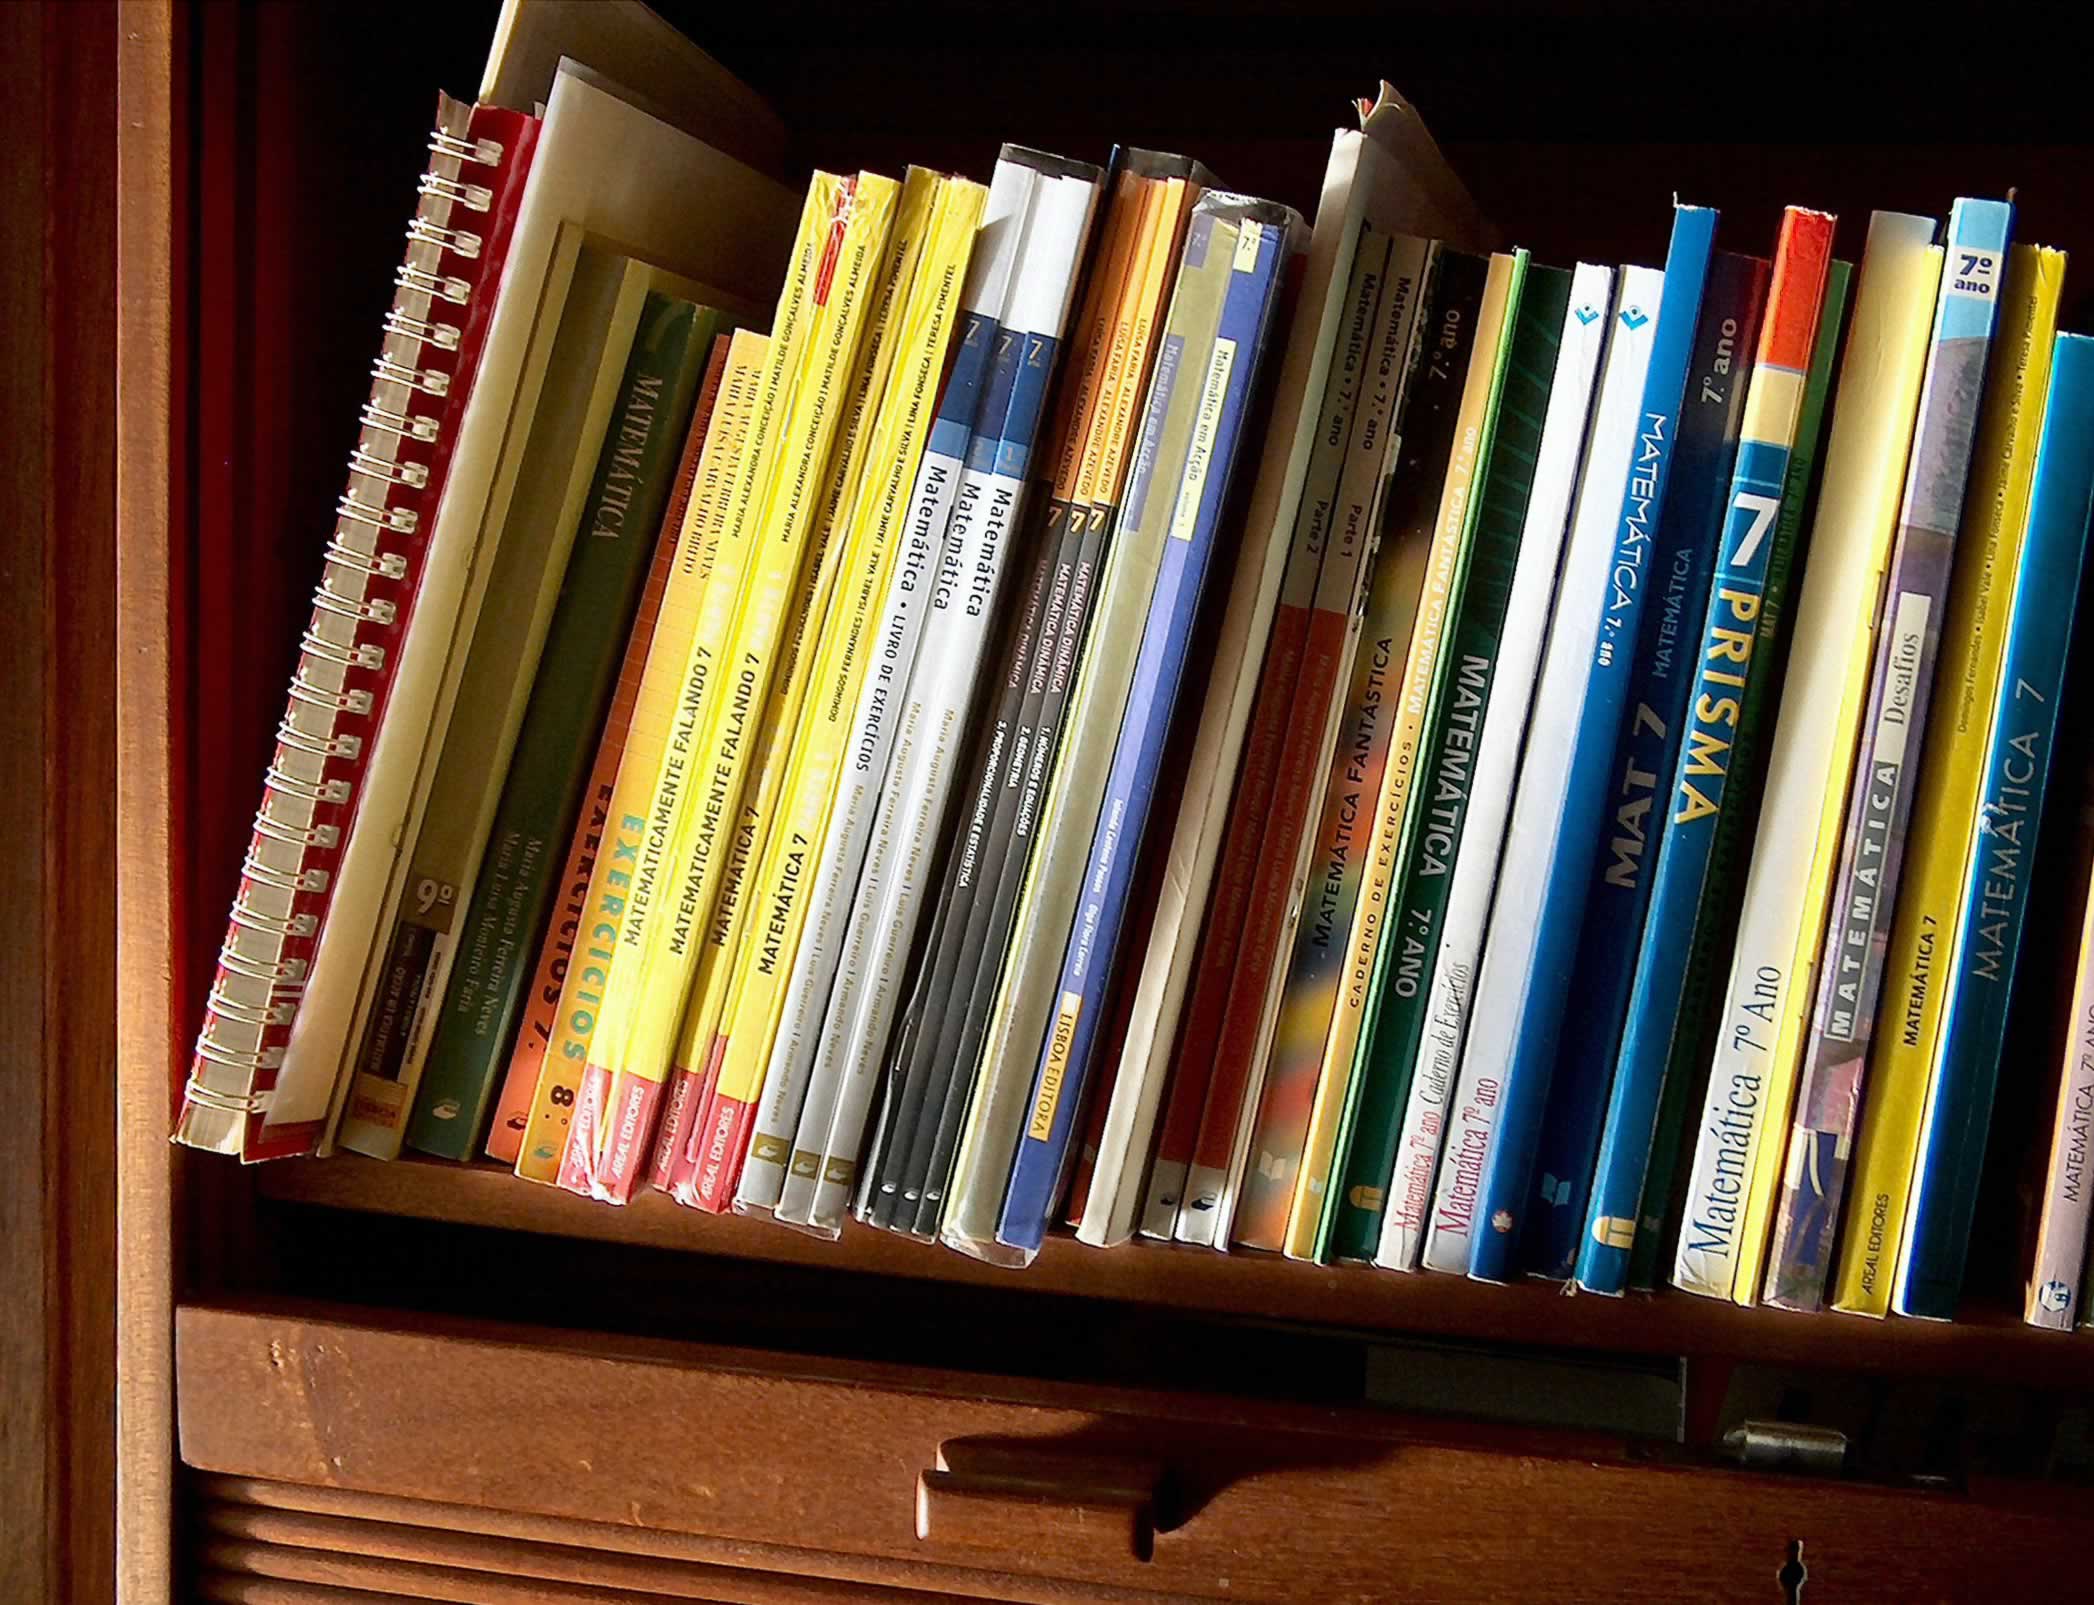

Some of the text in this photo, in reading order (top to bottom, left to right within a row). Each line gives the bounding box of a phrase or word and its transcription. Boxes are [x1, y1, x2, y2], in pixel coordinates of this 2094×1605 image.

[1954, 279, 1990, 294] ano
[1960, 254, 1992, 276] 7º
[1030, 340, 1042, 360] 7
[1329, 273, 1376, 448] Matemática ano
[1363, 277, 1410, 451] Matemática ano
[1436, 306, 1462, 350] ano
[1707, 315, 1739, 376] ano
[731, 285, 804, 538] MARIA ALEXANDRA CONCEIÇÃO MATILDE GONÇALVES
[742, 367, 762, 410] MARIA
[779, 243, 866, 543] MARIA ALEXANDRA CONCEIÇÃO MATILDE GONÇALVES ALMEIDA
[1056, 384, 1088, 491] ALEXANDRE AZEVEDO
[1078, 351, 1121, 496] FARIA ALEXANDRE AZEVEDO
[1098, 348, 1140, 494] FARIA ALEXANDRE AZEVEDO
[1145, 416, 1162, 438] em
[1187, 348, 1229, 482] Matemática em Acção
[591, 371, 663, 543] MATEMÁTICA
[680, 362, 747, 575] MARIA CARVALHO BRITO
[726, 413, 751, 471] AUGUSTA
[710, 471, 736, 536] FERREIRA
[827, 263, 956, 722] DOMINGOS FERNANDES ISABEL VALE JAIME CARVALHO SILVA LINA FONSECA TERESA PIMENTEL
[1048, 507, 1062, 528] 7
[1070, 510, 1086, 532] 7
[1090, 509, 1104, 531] 7
[1306, 499, 1328, 554] Parte 2
[1594, 412, 1667, 668] MATEMÁTICA ano
[1732, 492, 1779, 566] 7
[698, 537, 719, 581] NEVES
[932, 482, 981, 612] Matemática
[965, 487, 1013, 618] Matemática
[854, 464, 948, 773] Matemática LIVRO DE EXERCÍCIOS
[1028, 562, 1071, 696] MATEMÁTICA DINÂMICA
[1049, 560, 1091, 695] MATEMÁTICA DINÂMICA
[1650, 545, 1693, 679] MATEMÁTICA
[1673, 587, 1760, 830] PRISMA
[1883, 631, 1919, 725] Desafios
[2015, 677, 2047, 705] 7
[624, 645, 712, 946] MATEMATICAMENTE FALANDO 7
[668, 651, 761, 955] MATEMATICAMENTE FALANDO 7
[1006, 724, 1030, 790] 2. GEOMETRIA
[1014, 724, 1051, 838] 1. NÚMEROS E EQUAÇÕES
[1602, 701, 1670, 889] MAT 7
[496, 829, 521, 872] Maria
[518, 835, 544, 879] Maria
[744, 805, 760, 820] 7
[878, 789, 901, 838] Ferreira
[911, 796, 933, 845] Ferreira
[957, 729, 1003, 889] PROPORCIONALIDADE ESTATÍSTICA
[1391, 653, 1490, 1000] MATEMÁTICA 7.º ANO
[757, 832, 808, 975] MATEMÁTICA 7
[1349, 912, 1377, 1008] CADERNO
[1371, 878, 1384, 902] DE
[1378, 740, 1412, 866] EXERCÍCIOS
[1830, 762, 1895, 1037] MATEMÁTICA
[472, 993, 498, 1037] Neves
[830, 976, 855, 1033] Armando
[863, 984, 887, 1040] Armando
[1903, 914, 1937, 1046] MATEMÁTICA 7
[777, 1037, 800, 1089] Armando
[1031, 1012, 1073, 1133] LISBOA EDITORA
[1418, 1046, 1453, 1106] Caderno
[1429, 1028, 1456, 1048] de
[609, 1084, 645, 1179] AREAL EDITORES
[665, 1077, 689, 1134] EDITORES
[699, 1104, 736, 1200] AREAL EDITORES
[1412, 1108, 1442, 1135] ano
[1686, 1068, 1762, 1259] Matemática
[1739, 961, 1783, 1023] Ano
[2062, 1083, 2092, 1202] MATEMÁTICA
[1394, 1151, 1434, 1232] Matemática
[1436, 1124, 1488, 1239] Matemática
[1469, 1074, 1498, 1108] ano
[1861, 1192, 1890, 1295] AREAL EDITORES
